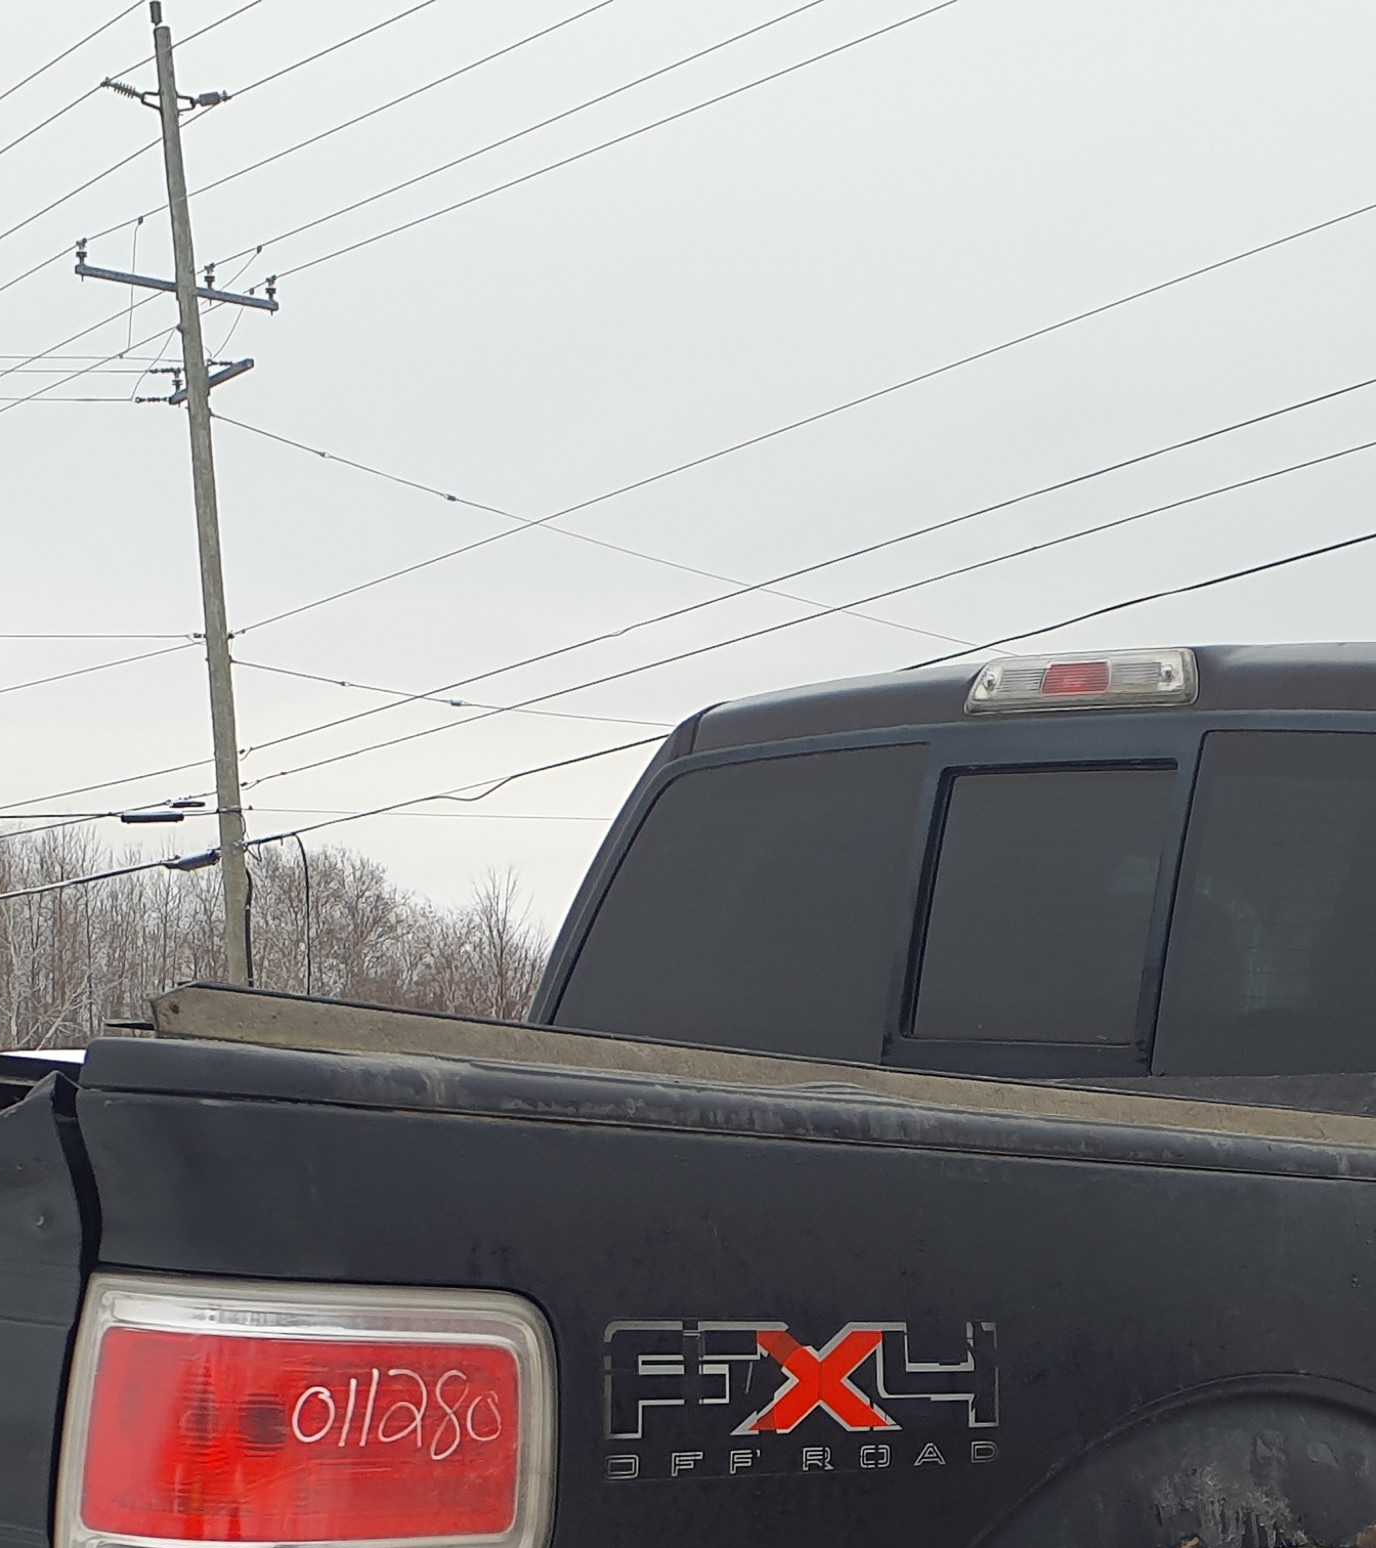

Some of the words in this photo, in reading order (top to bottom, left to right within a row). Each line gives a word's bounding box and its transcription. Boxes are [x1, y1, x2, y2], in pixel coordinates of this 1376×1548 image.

[292, 1367, 502, 1461] 011280
[603, 1320, 999, 1440] FX4
[802, 1440, 999, 1472] ROAD
